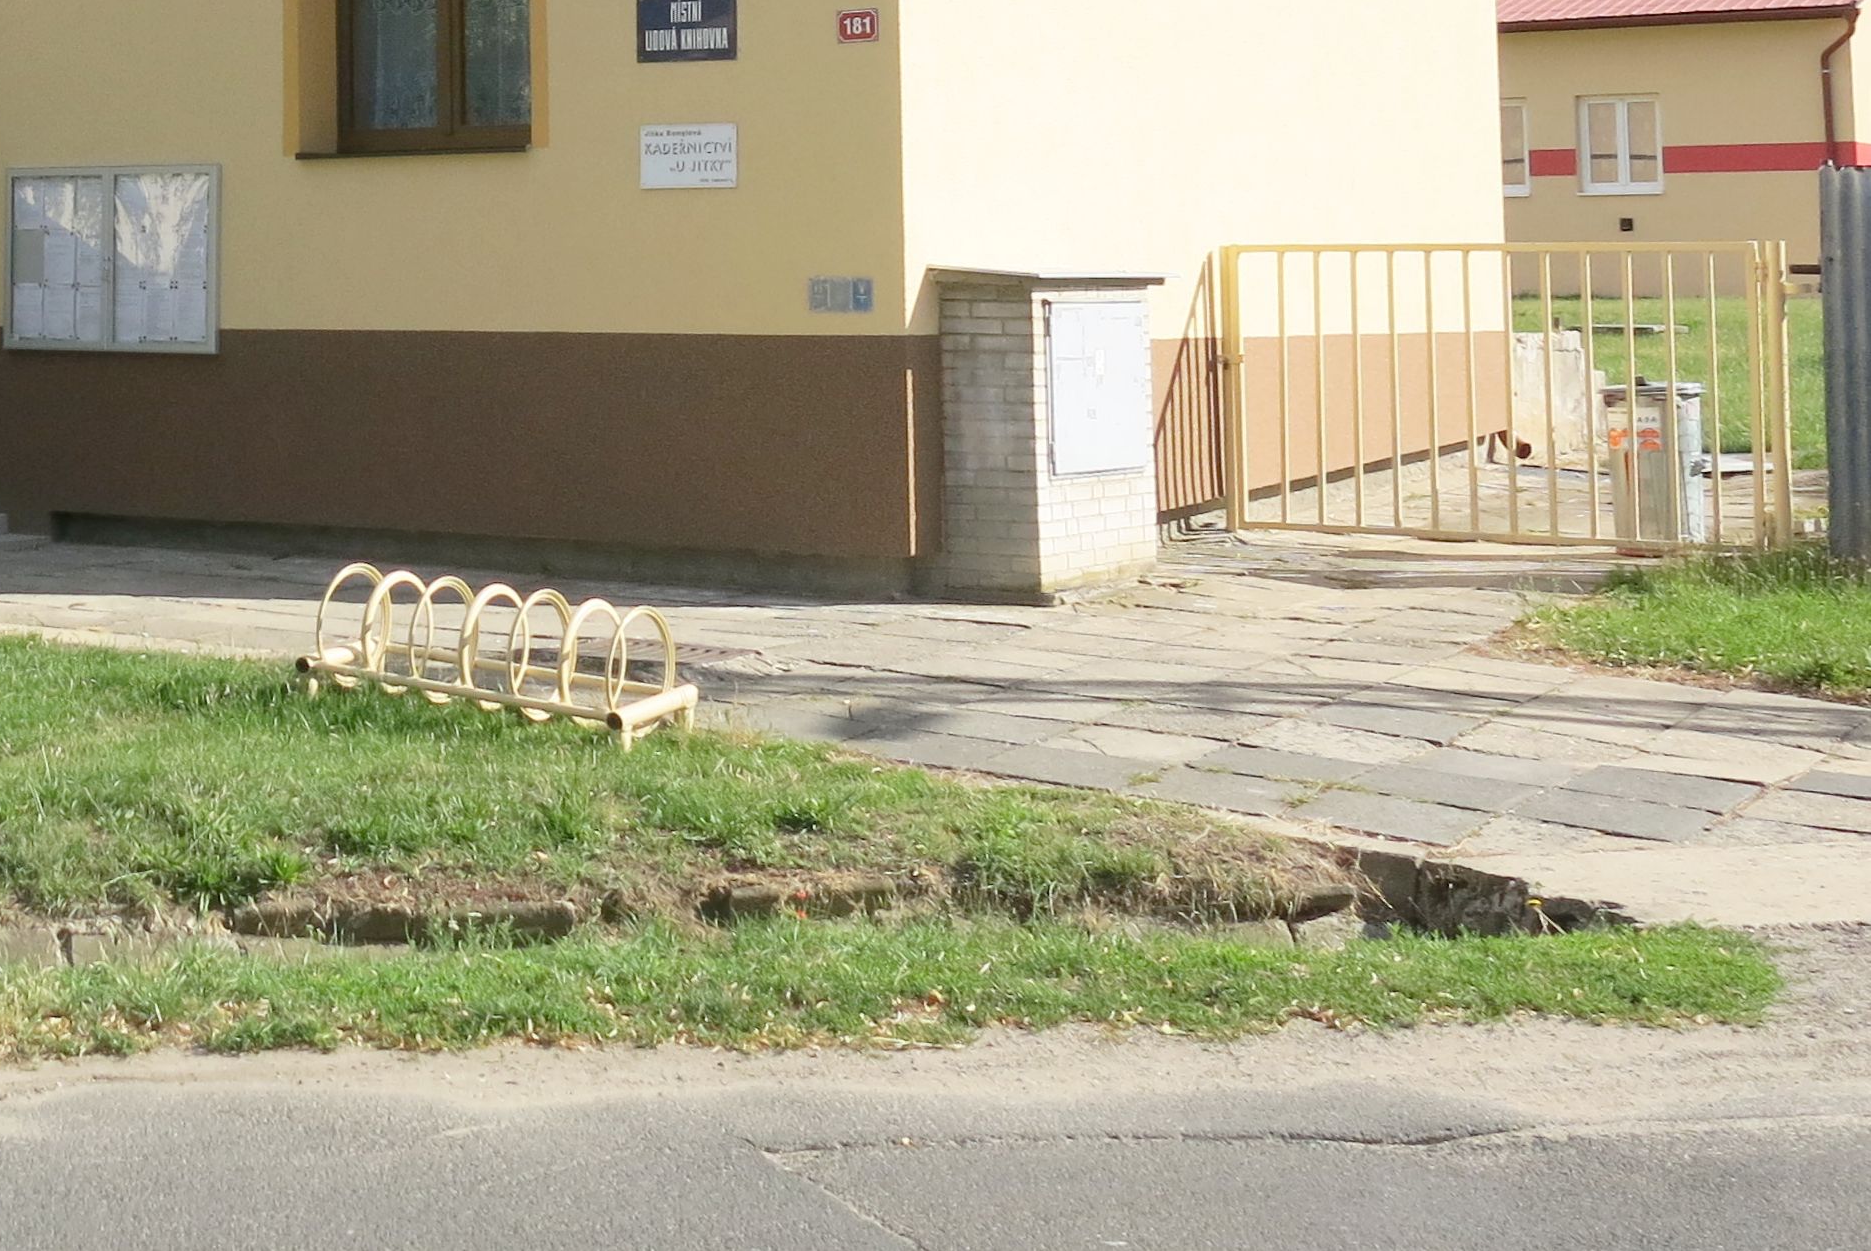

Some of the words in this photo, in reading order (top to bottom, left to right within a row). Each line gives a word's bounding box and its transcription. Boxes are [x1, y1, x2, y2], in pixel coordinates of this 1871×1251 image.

[843, 16, 872, 35] 181
[644, 26, 679, 52] LIDOVÁ
[680, 27, 729, 51] KNIHOVNA
